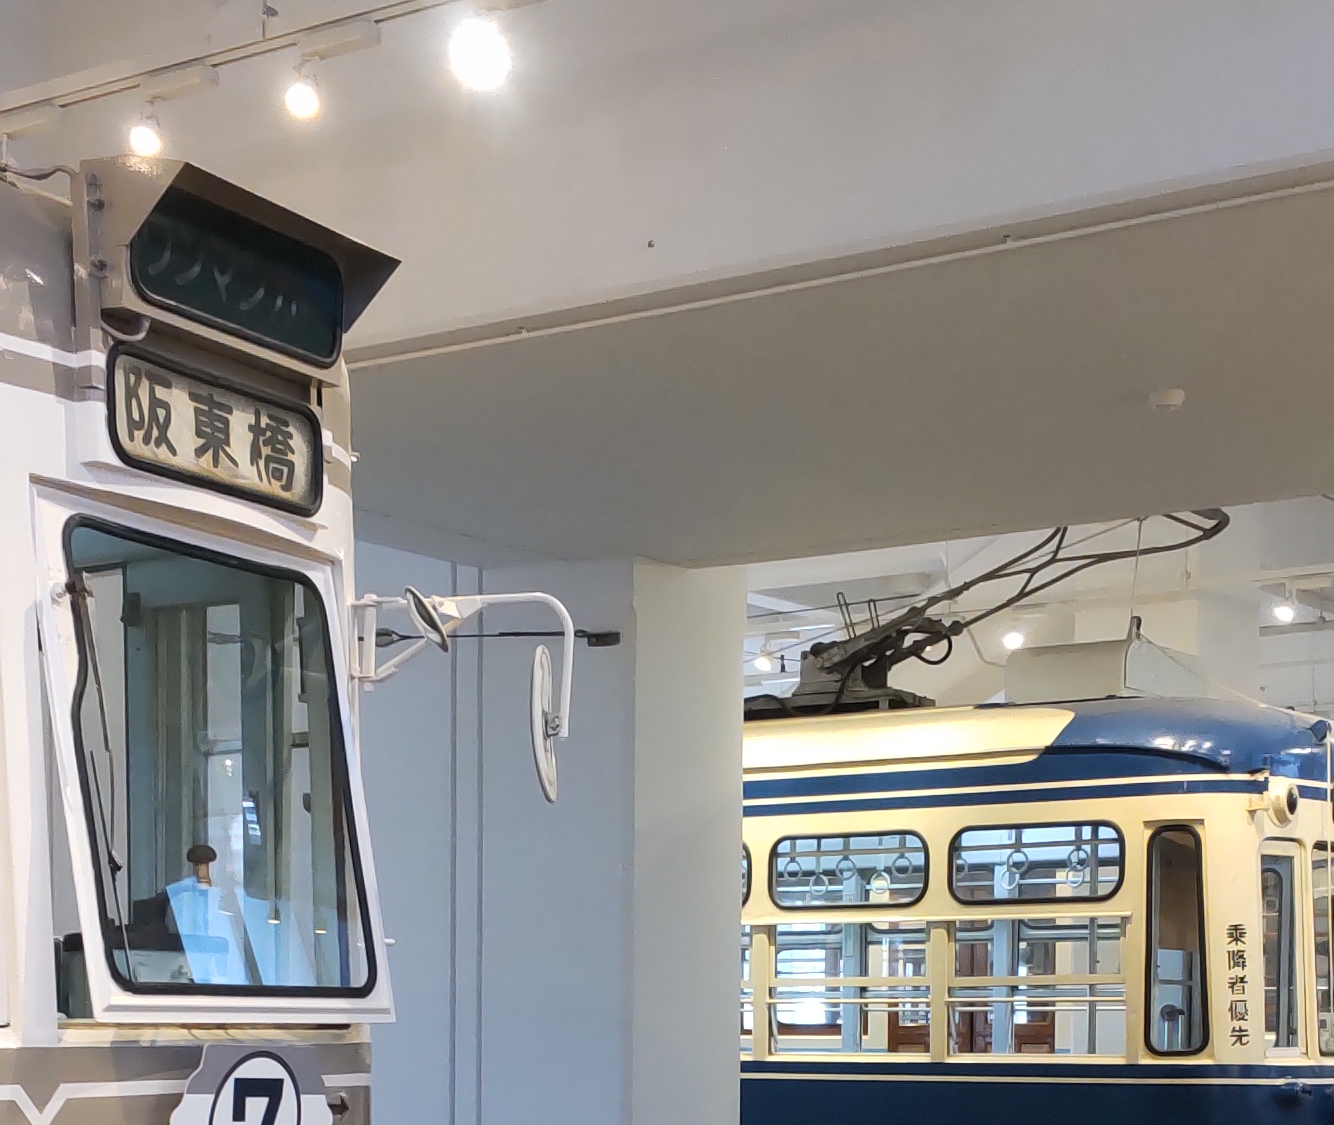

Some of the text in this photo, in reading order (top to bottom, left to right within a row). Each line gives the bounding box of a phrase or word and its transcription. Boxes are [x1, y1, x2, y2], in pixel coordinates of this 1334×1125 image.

[123, 364, 296, 492] 阪東橋
[1226, 924, 1250, 1046] 乗降者優先
